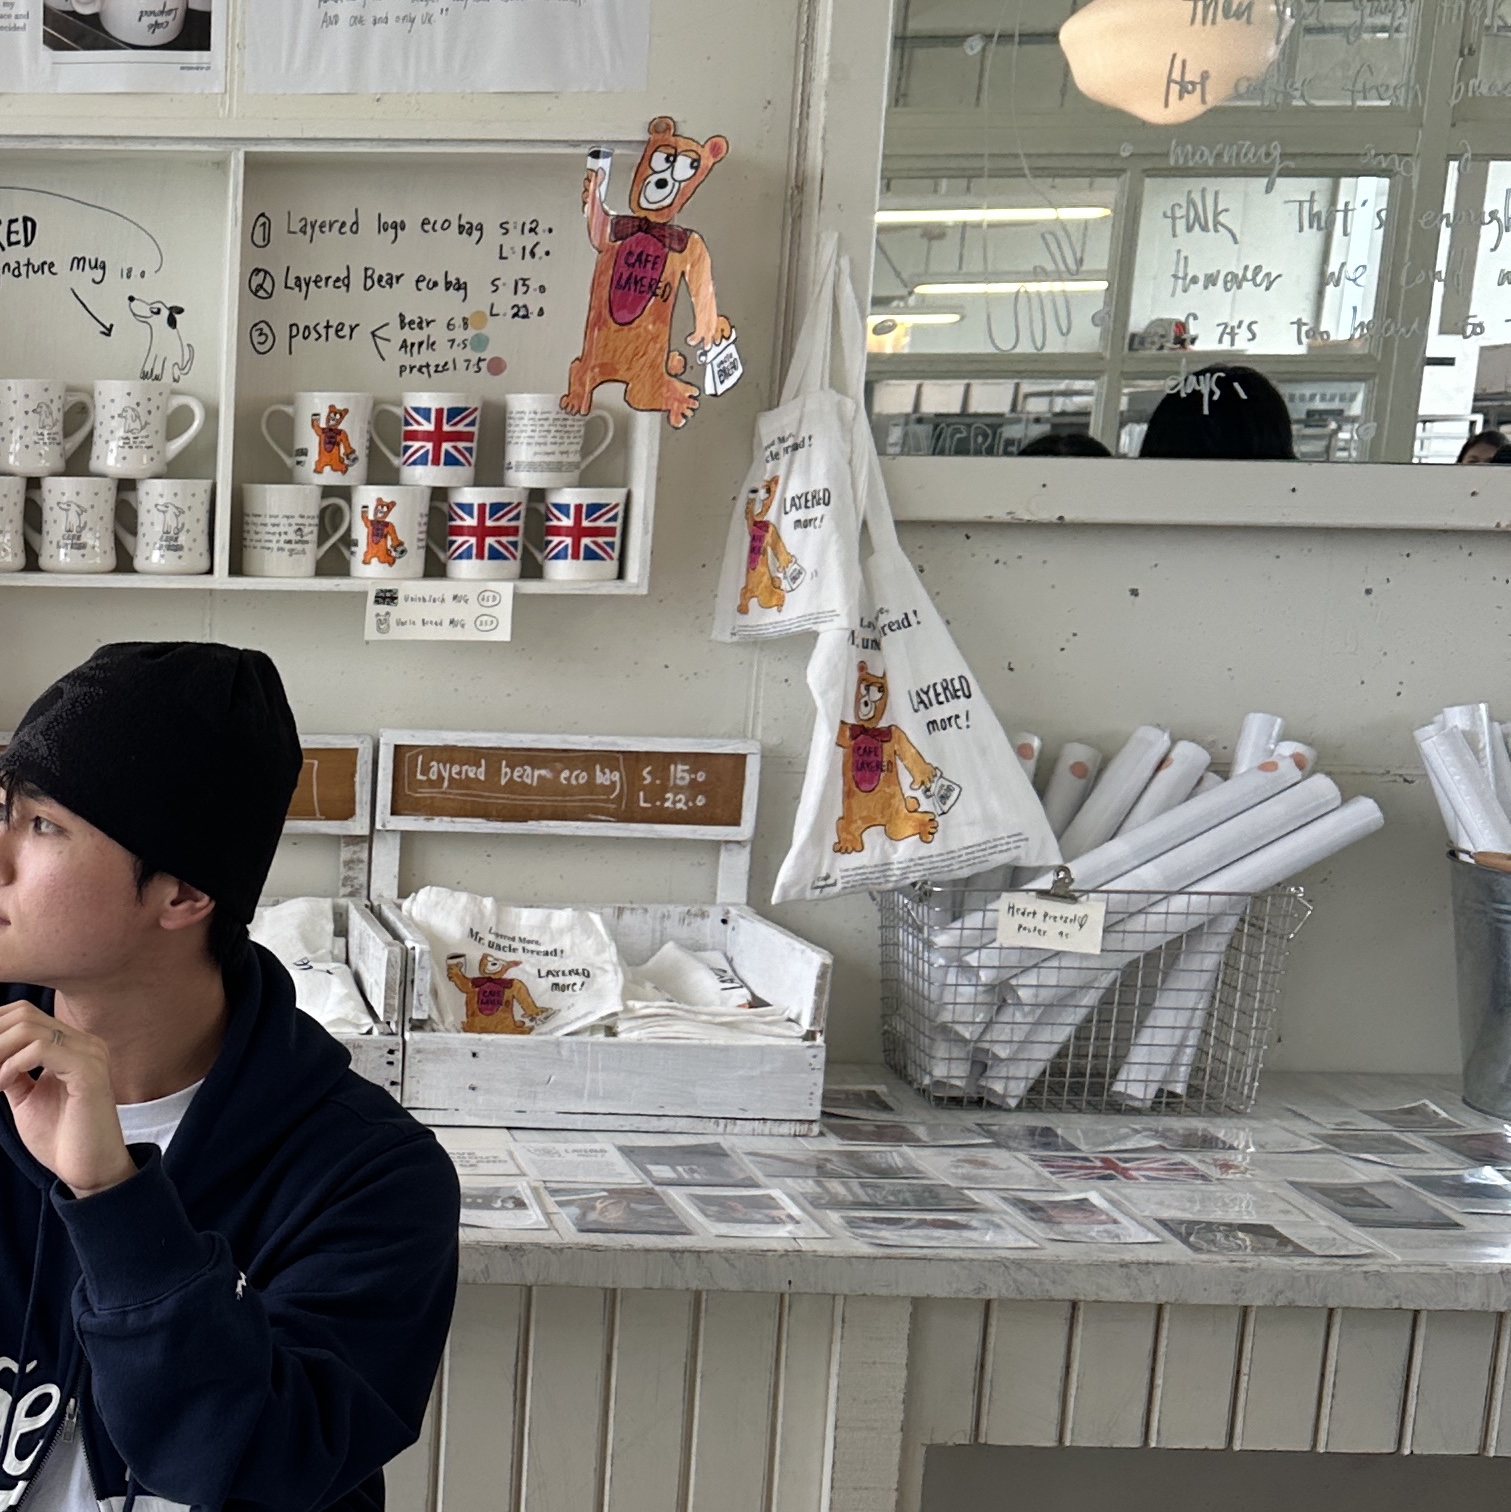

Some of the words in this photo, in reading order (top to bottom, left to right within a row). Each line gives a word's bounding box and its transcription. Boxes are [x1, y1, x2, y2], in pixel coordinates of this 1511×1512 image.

[14, 11, 30, 19] and
[395, 14, 416, 33] only
[286, 207, 360, 243] Layered
[377, 213, 406, 244] logo
[420, 217, 452, 232] eco
[457, 213, 484, 245] bag
[70, 256, 107, 285] mug
[623, 250, 661, 269] CAFE
[283, 264, 351, 301] Layered
[363, 266, 405, 292] Bear
[444, 270, 468, 302] bag
[614, 271, 672, 303] LAYERED
[398, 312, 436, 331] Bear
[289, 319, 361, 355] poster
[398, 334, 437, 357] Apple
[447, 338, 468, 350] 7.5
[399, 358, 457, 379] pretzel
[783, 488, 831, 515] LAYERED
[881, 608, 921, 637] read!
[908, 674, 972, 713] LAYERED
[926, 710, 970, 736] more!
[416, 757, 485, 791] Layered
[500, 760, 541, 787] bear
[560, 767, 588, 785] eco
[594, 763, 621, 799] bag
[1007, 901, 1037, 919] Heart
[468, 927, 485, 947] Mr.
[488, 940, 519, 954] uncle
